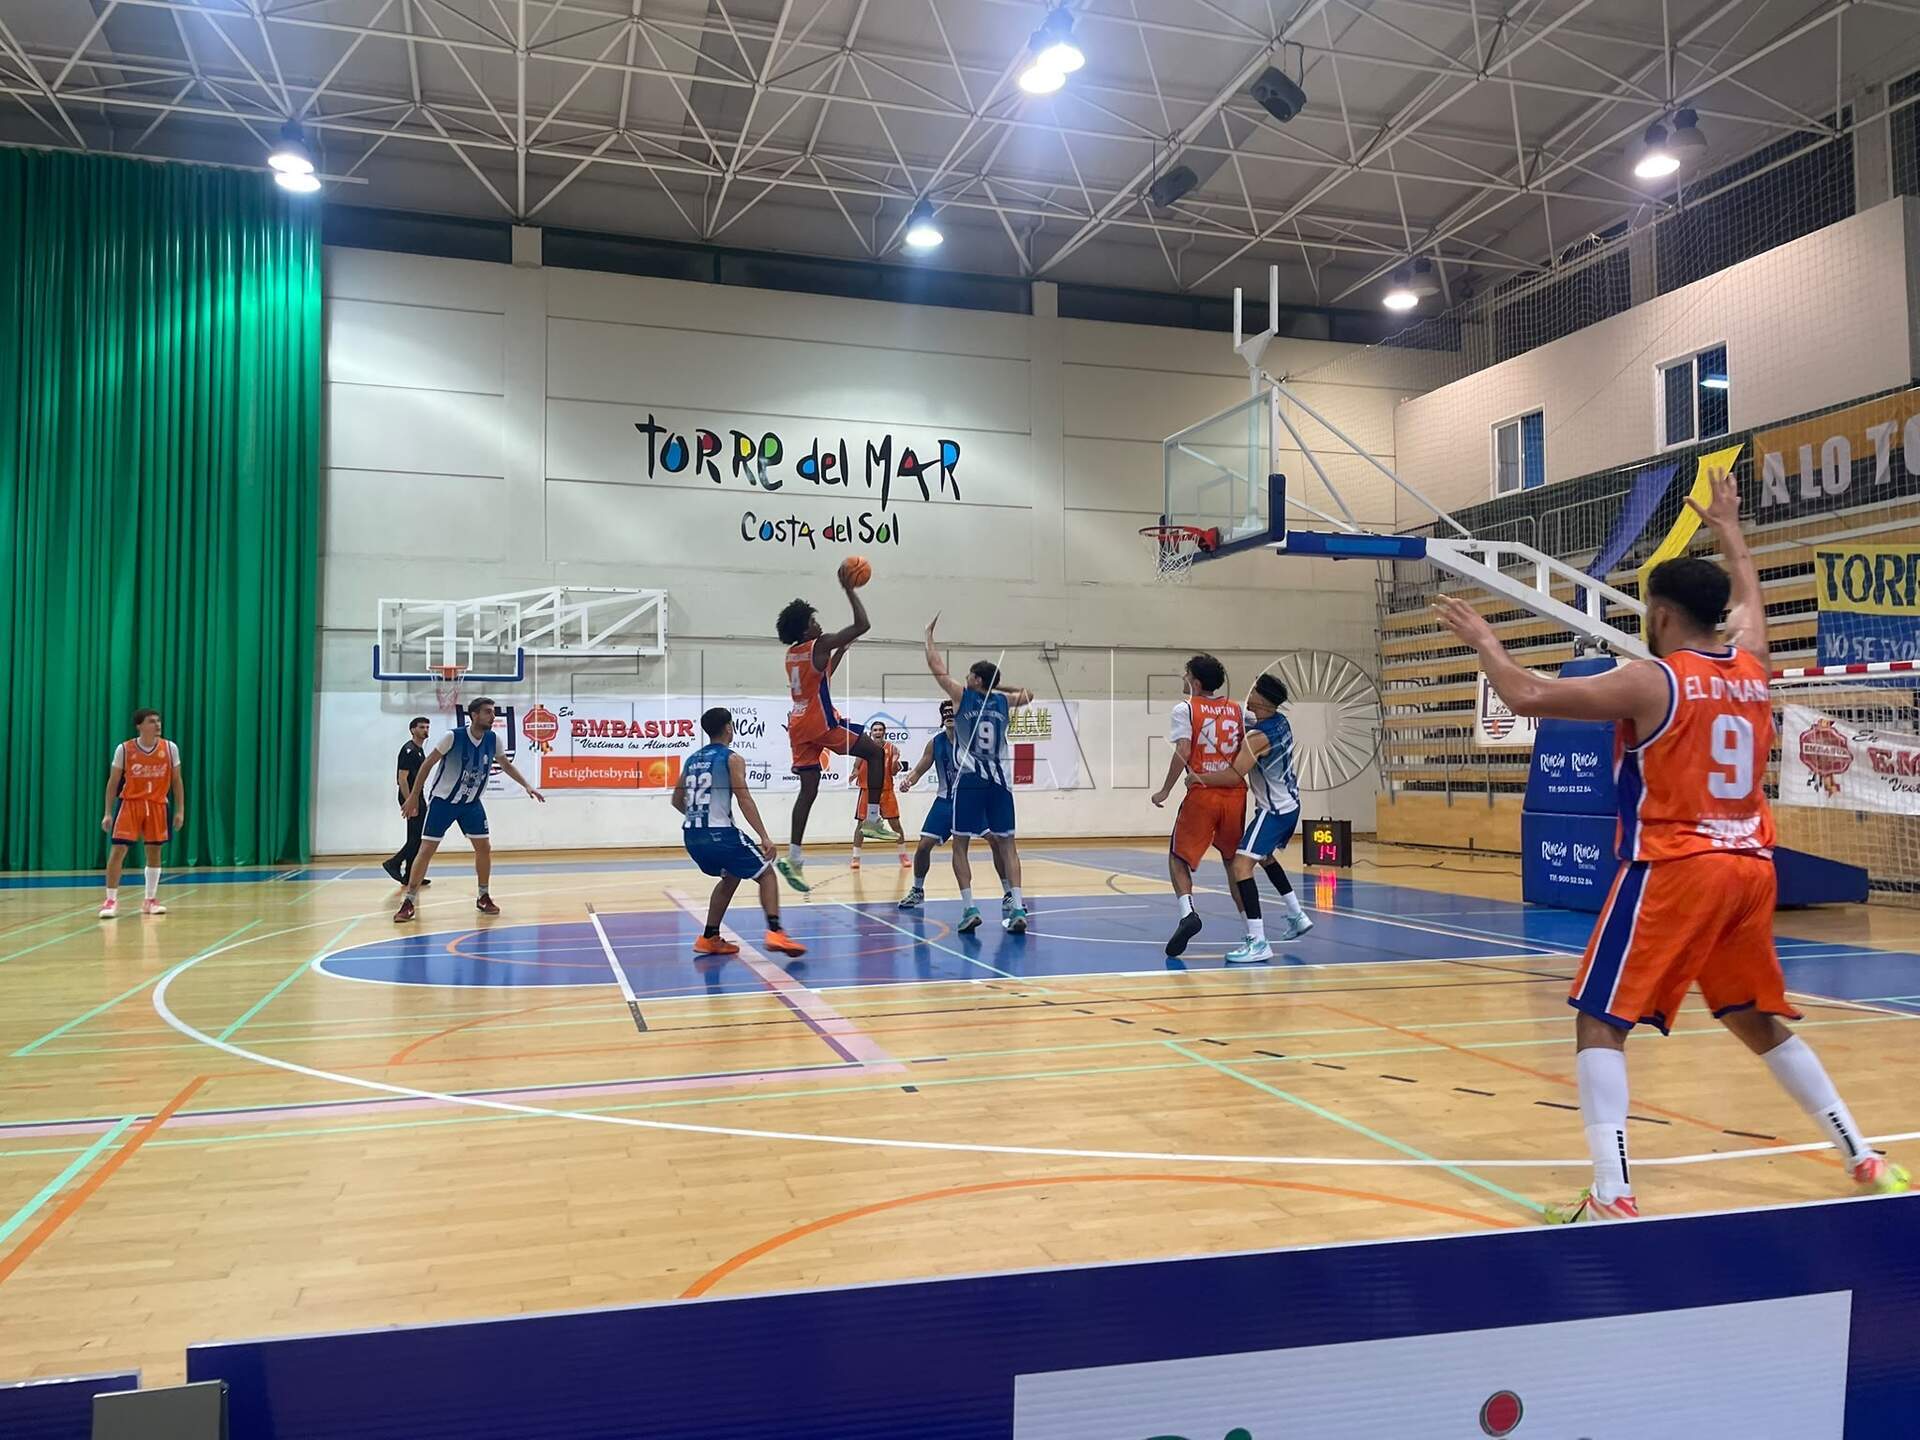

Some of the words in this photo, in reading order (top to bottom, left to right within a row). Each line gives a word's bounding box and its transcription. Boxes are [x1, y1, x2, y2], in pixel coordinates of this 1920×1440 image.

[796, 437, 848, 487] del
[865, 434, 961, 512] MAR
[1760, 452, 1790, 508] A
[823, 516, 851, 544] del
[858, 512, 899, 545] Sol
[559, 707, 574, 718] En
[729, 708, 757, 719] INICAS
[571, 720, 696, 739] EMBASUR
[884, 732, 908, 741] rero
[979, 721, 996, 751] 9
[1198, 718, 1239, 754] 43
[1708, 713, 1754, 799] 9
[749, 770, 772, 783] Rojo
[821, 773, 839, 781] AYO
[1319, 845, 1337, 861] 14
